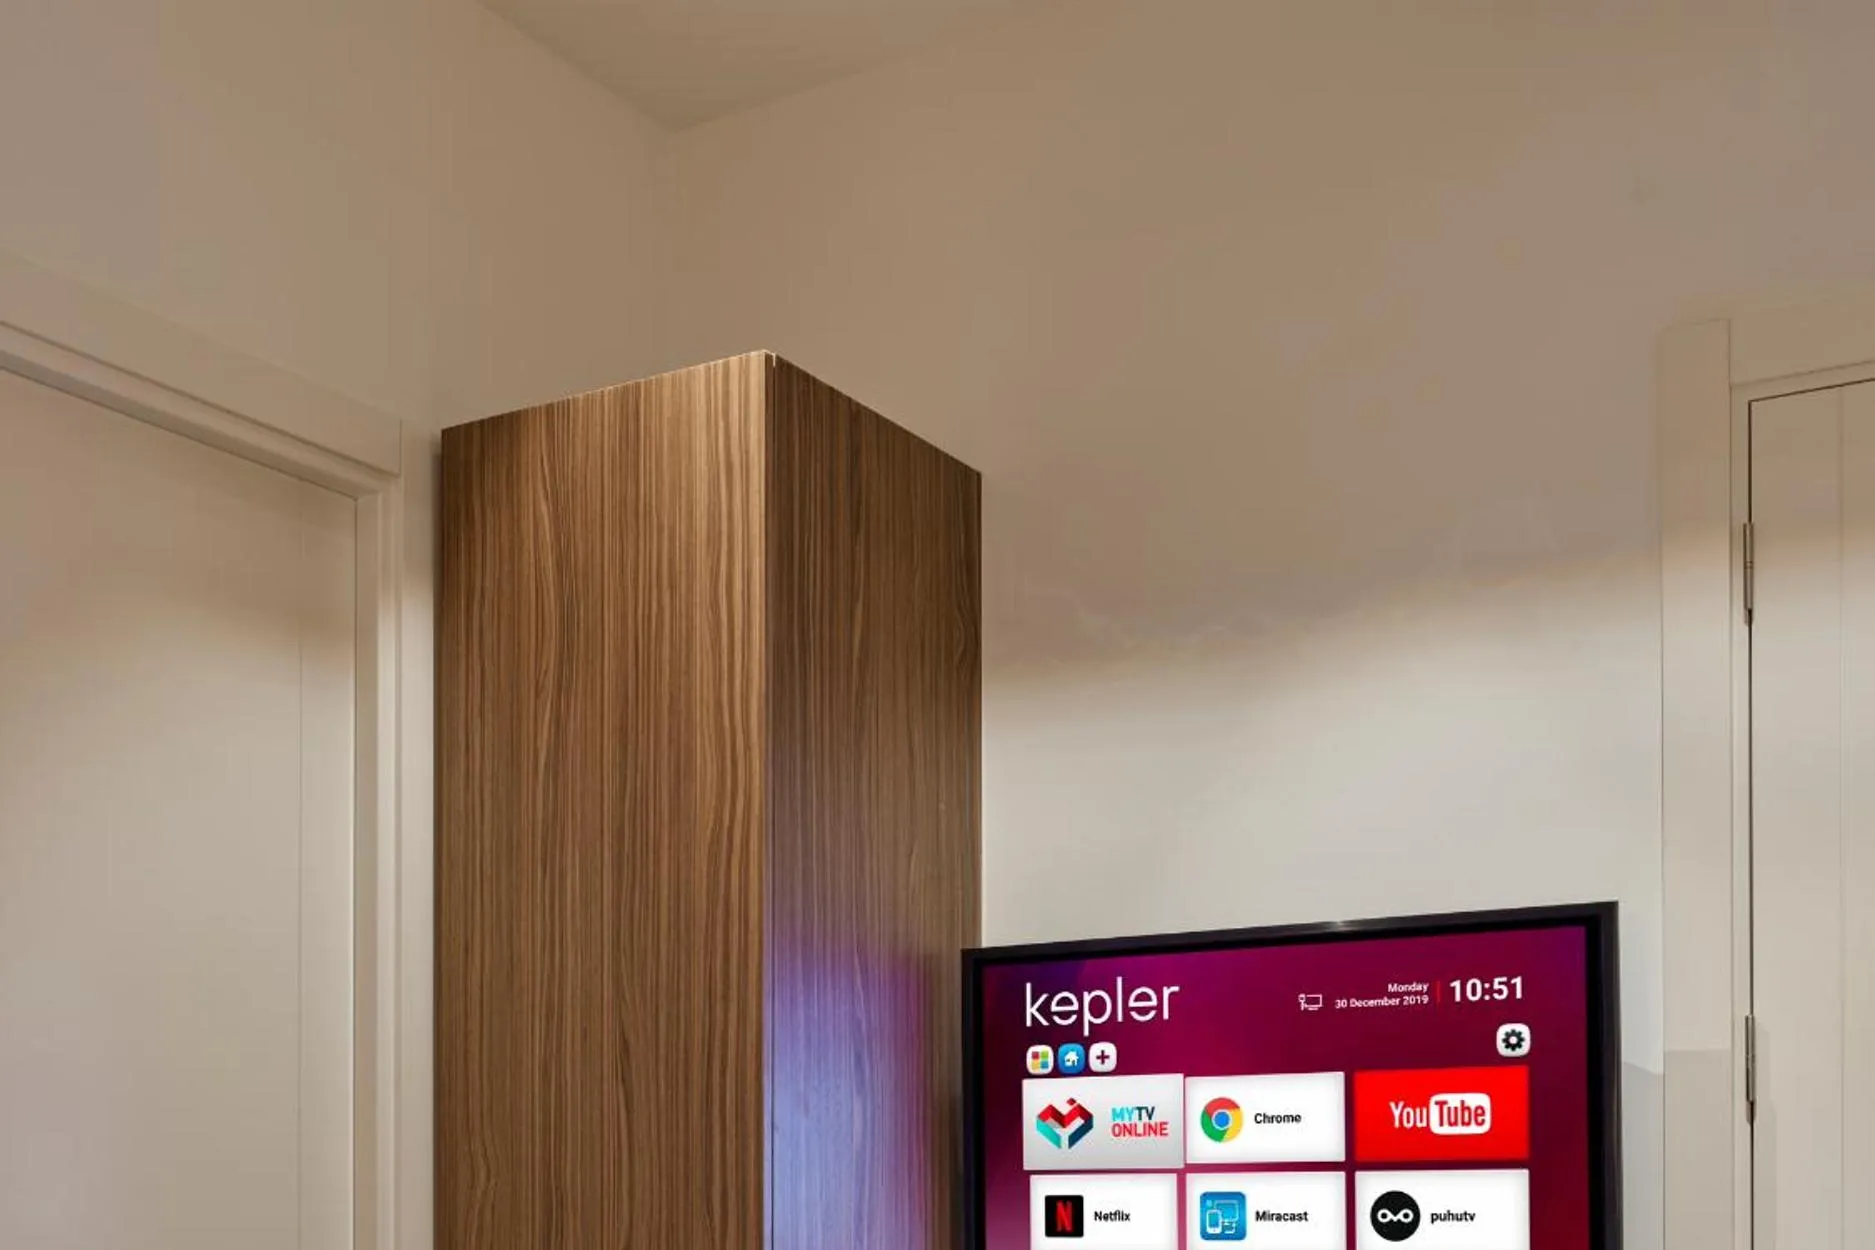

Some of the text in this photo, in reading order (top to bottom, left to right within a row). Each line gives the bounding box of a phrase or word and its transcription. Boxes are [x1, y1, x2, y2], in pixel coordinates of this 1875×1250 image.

[1388, 982, 1430, 994] Monday
[1450, 976, 1523, 1003] 10:51
[1026, 976, 1180, 1037] kepler
[1335, 994, 1430, 1009] 30 December 2019
[1111, 1106, 1156, 1122] MYTV
[1254, 1112, 1302, 1125] Chrome
[1389, 1099, 1486, 1129] YouTube
[1111, 1121, 1170, 1138] ONLINE
[1094, 1209, 1131, 1222] Netflix
[1254, 1209, 1309, 1223] Miracast
[1430, 1209, 1477, 1225] puhutv
